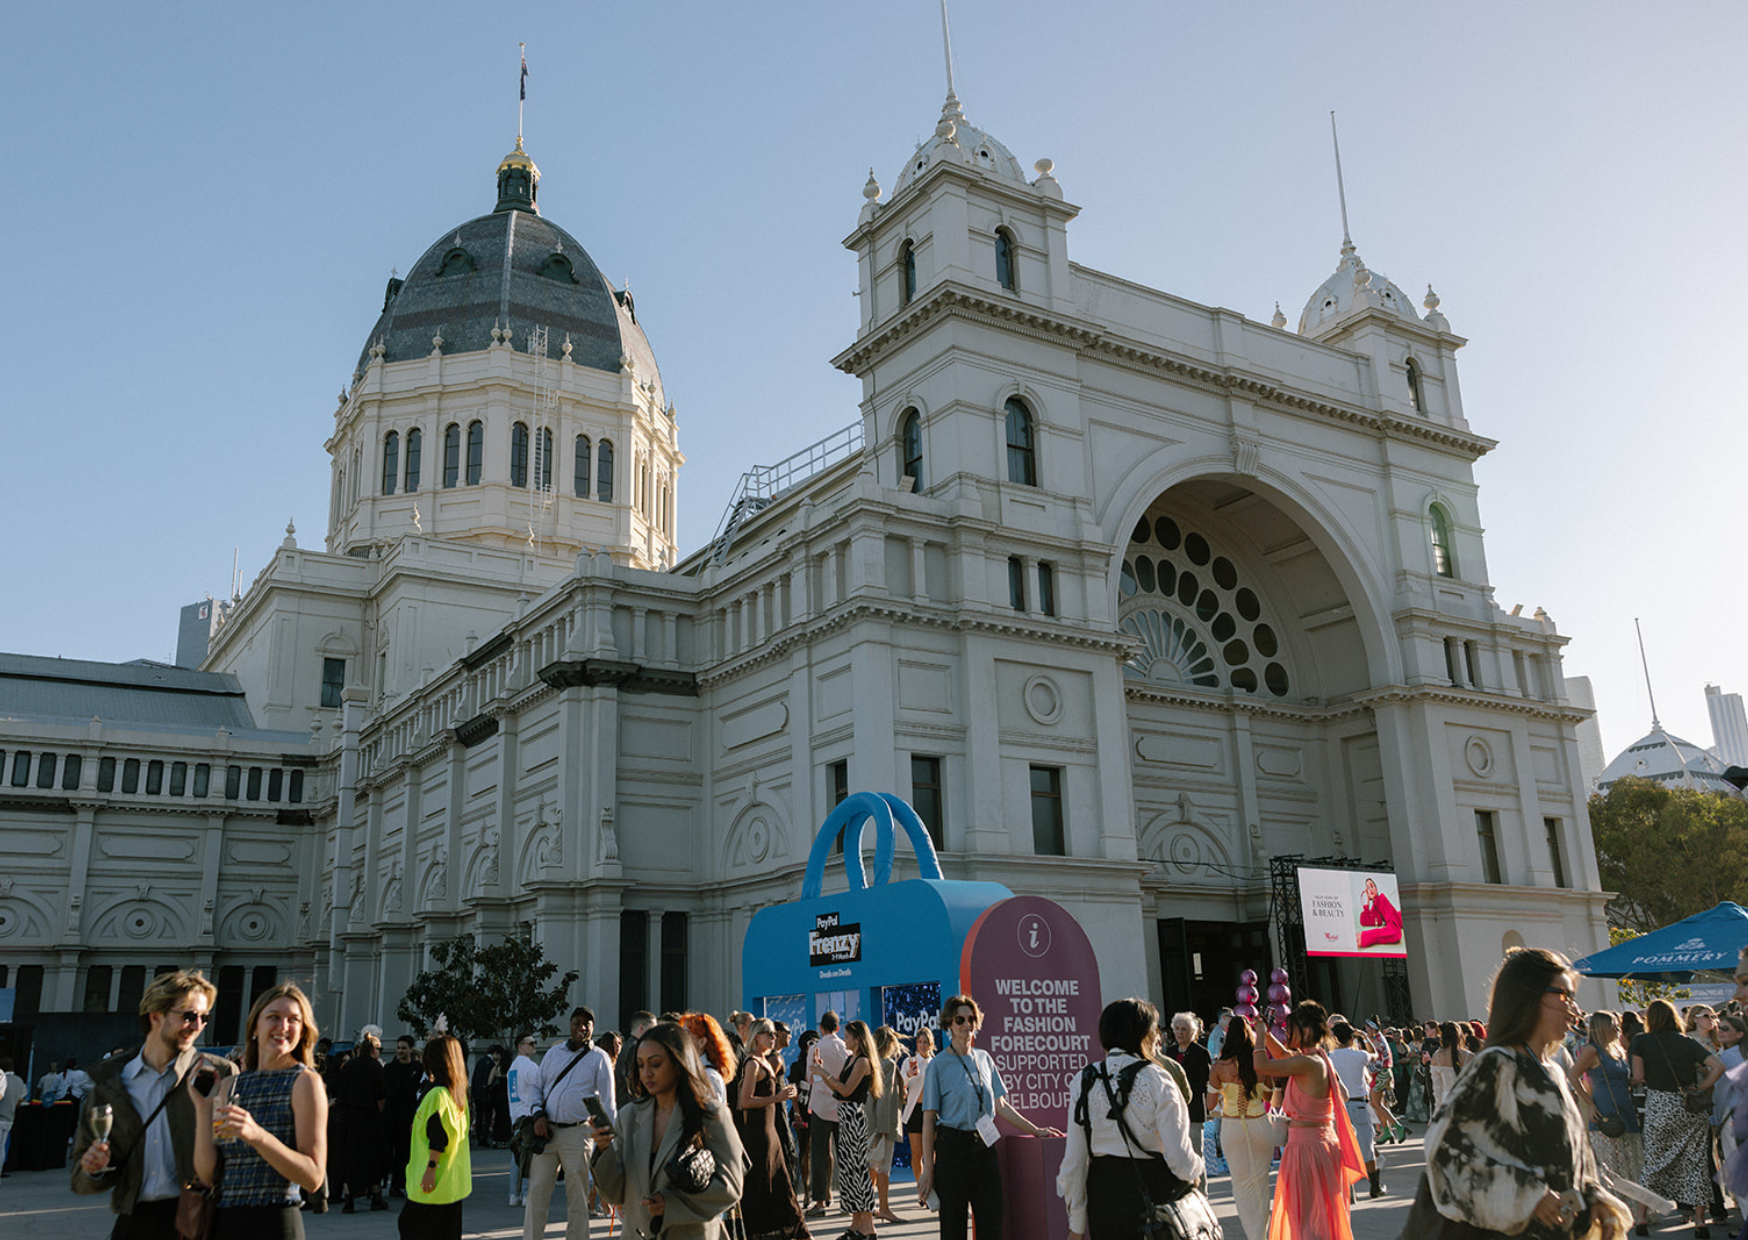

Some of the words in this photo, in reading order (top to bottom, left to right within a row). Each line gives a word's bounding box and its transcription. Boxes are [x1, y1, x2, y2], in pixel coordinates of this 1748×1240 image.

[1312, 900, 1342, 908] FASHION
[1318, 909, 1344, 917] BEAUTY
[817, 915, 838, 930] PayPal
[809, 931, 860, 958] Frenzy
[1632, 952, 1728, 965] POMMERY
[995, 979, 1079, 995] WELCOME
[1009, 998, 1033, 1014] TO
[1034, 998, 1067, 1014] THE
[1003, 1016, 1076, 1033] FASHION
[991, 1035, 1090, 1052] FORECOURT
[996, 1053, 1088, 1071] SUPPORTED
[1003, 1073, 1023, 1090] BY
[1026, 1072, 1061, 1090] CITY
